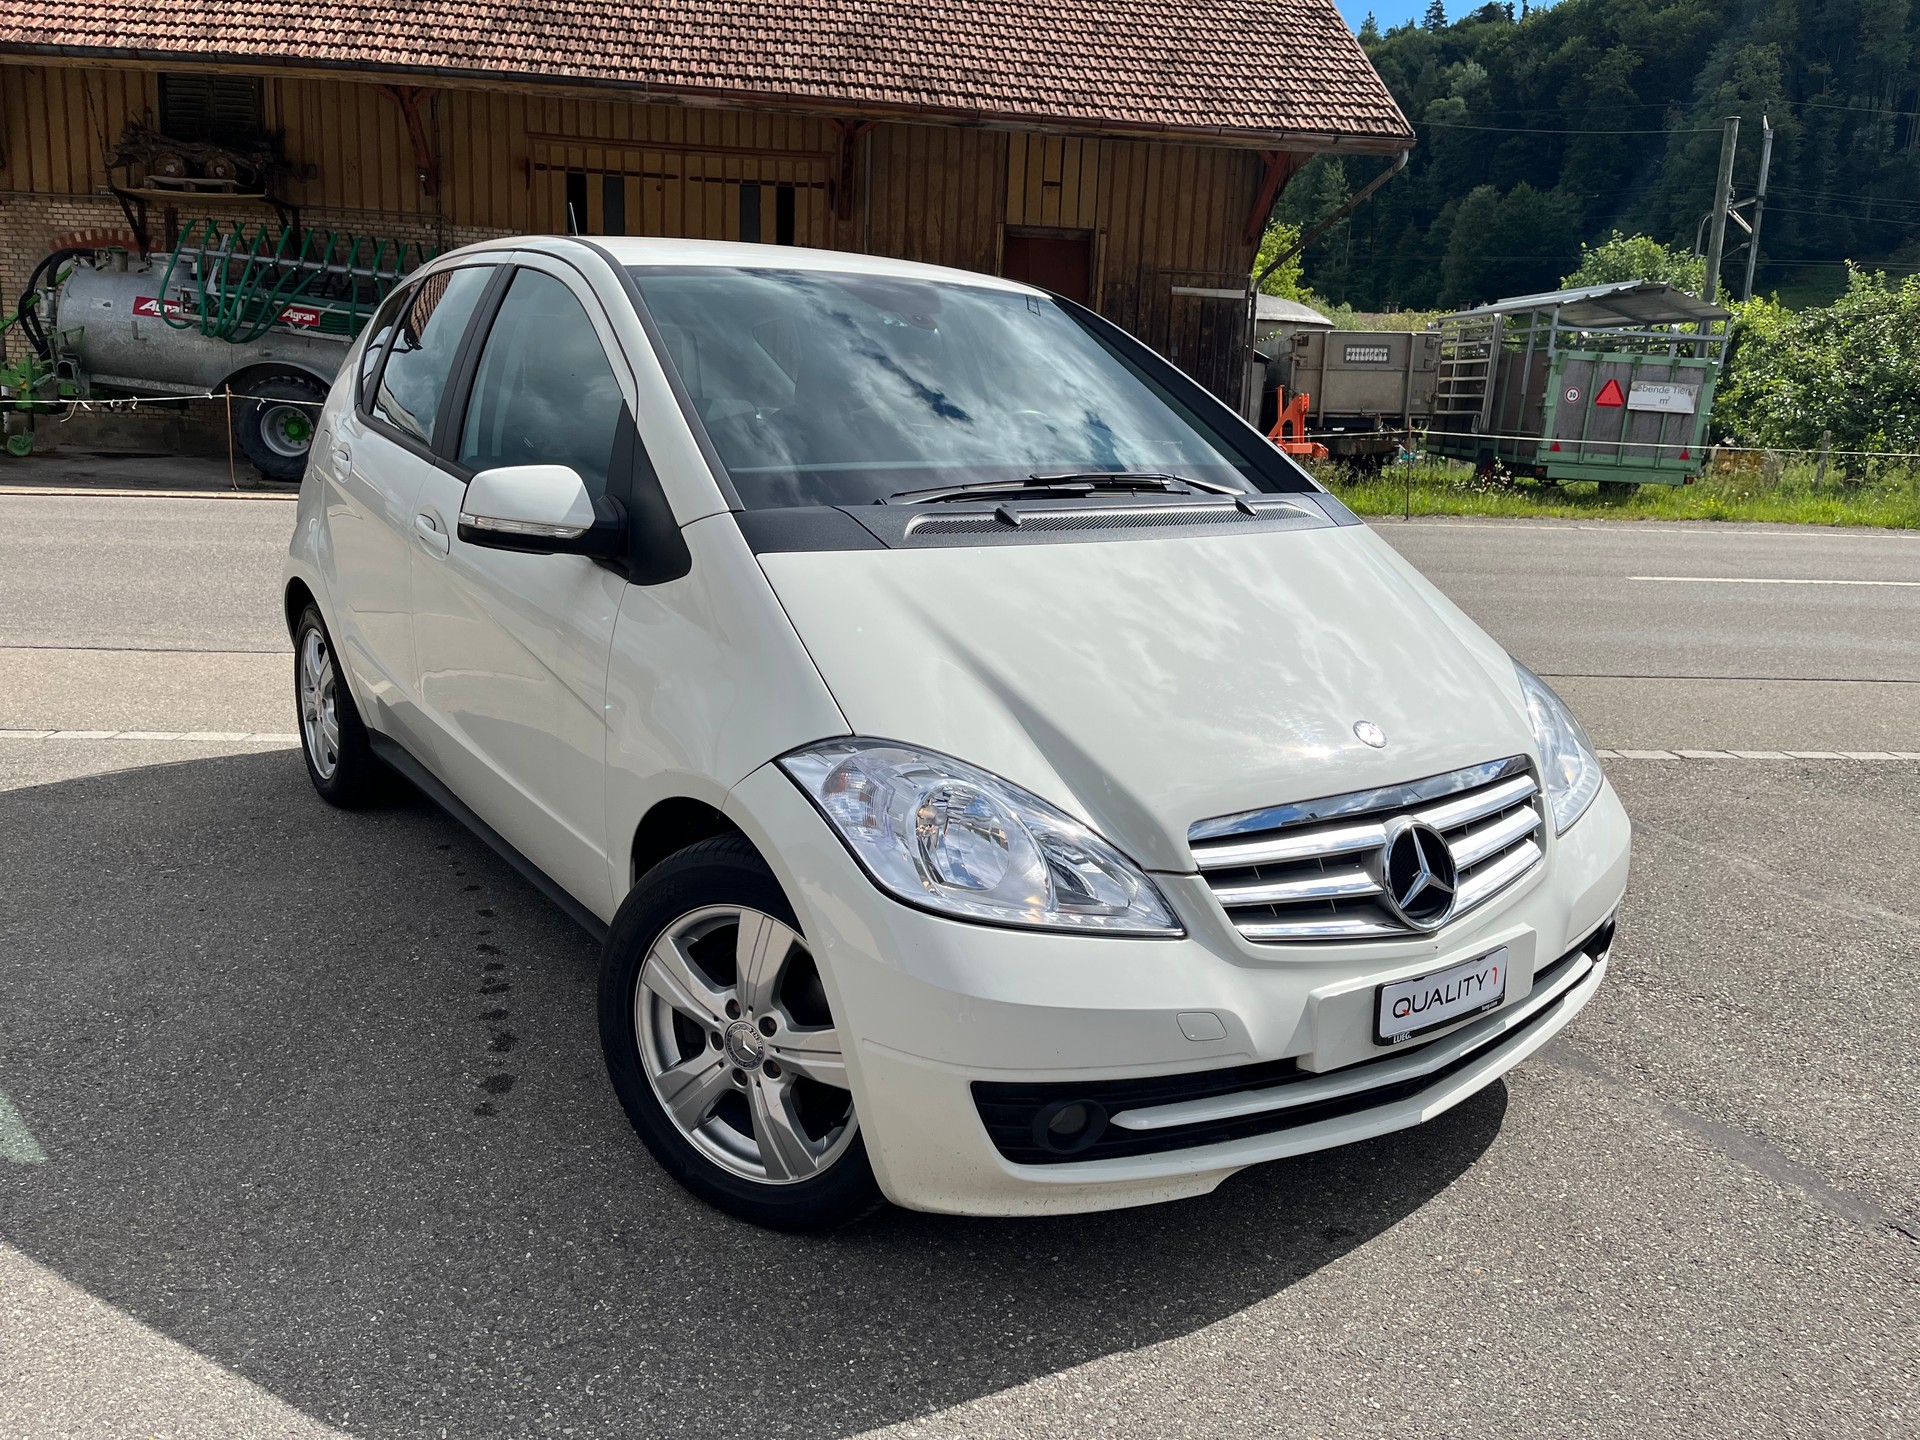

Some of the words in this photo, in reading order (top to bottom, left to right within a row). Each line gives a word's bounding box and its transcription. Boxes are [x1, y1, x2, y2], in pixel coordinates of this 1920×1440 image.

[282, 309, 316, 321] Agrar
[1568, 391, 1577, 399] 30
[1393, 970, 1488, 1018] QUALITY
